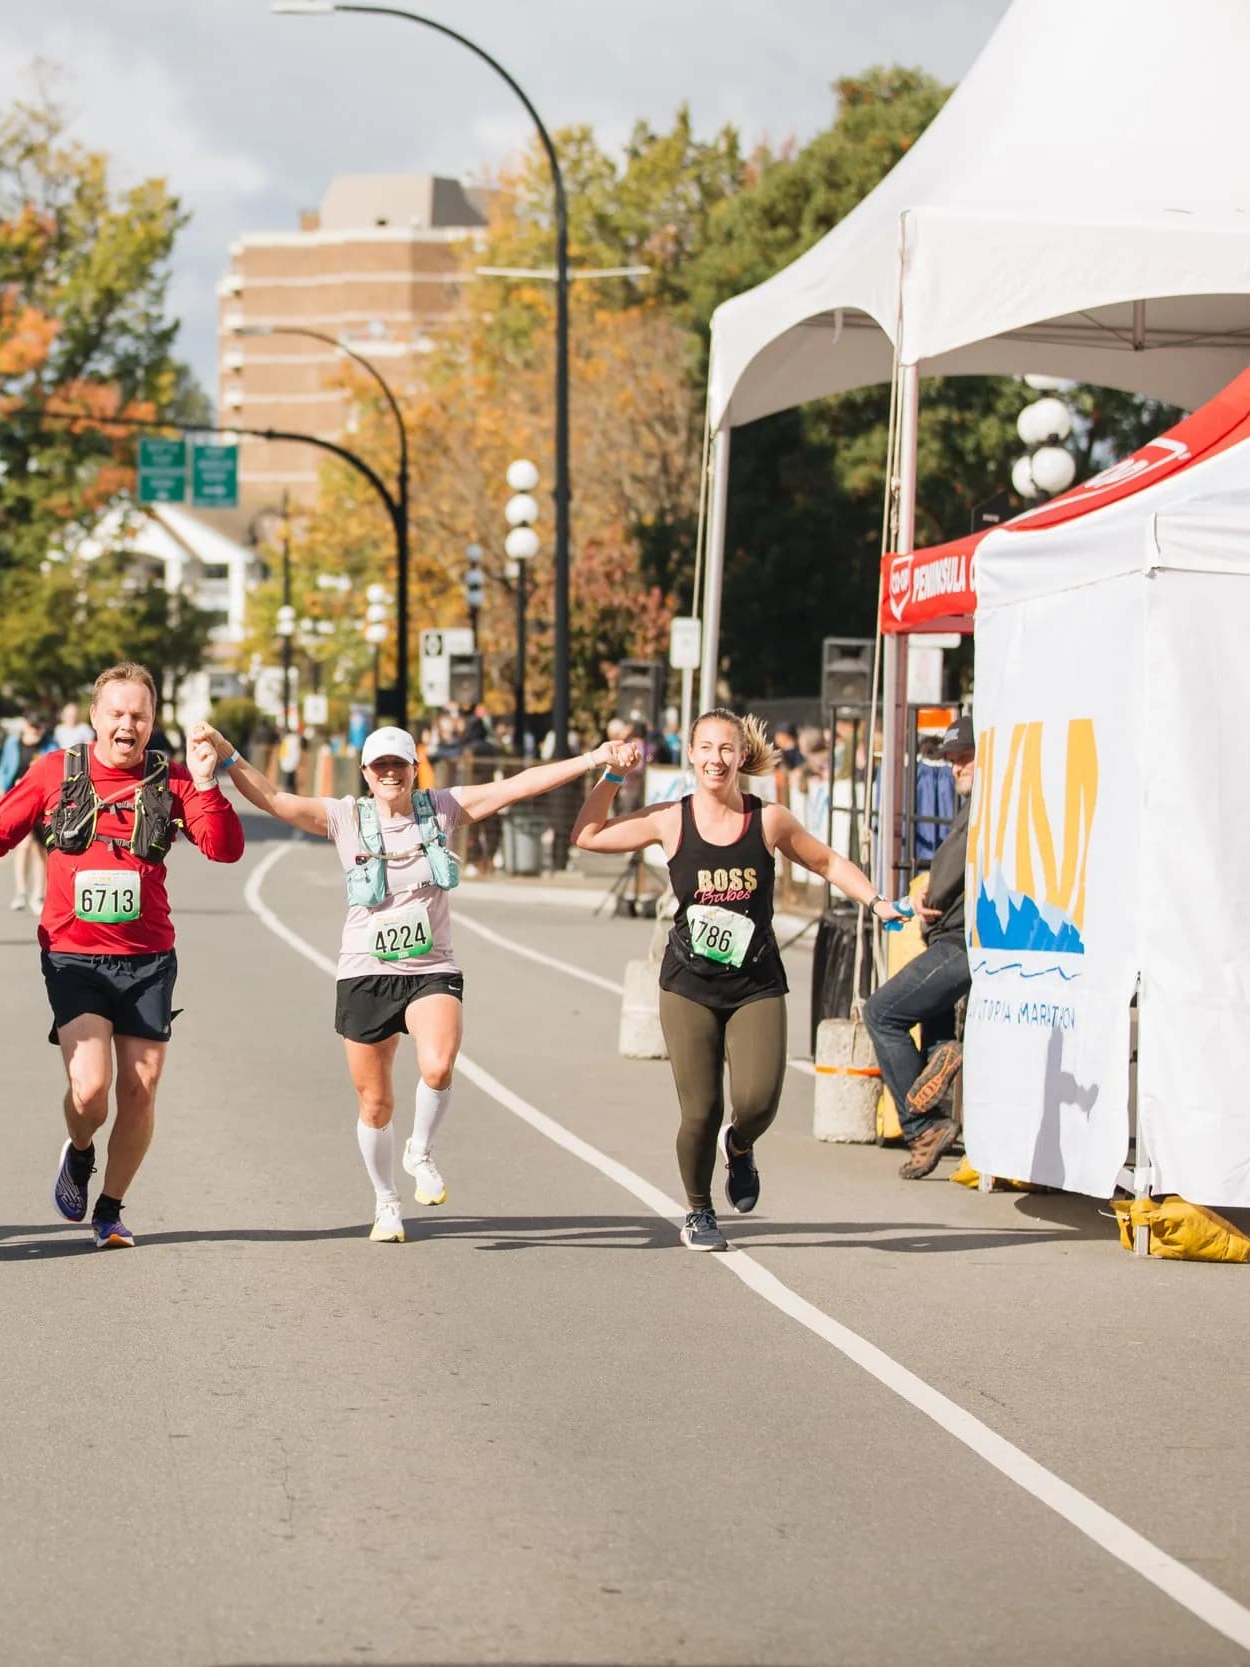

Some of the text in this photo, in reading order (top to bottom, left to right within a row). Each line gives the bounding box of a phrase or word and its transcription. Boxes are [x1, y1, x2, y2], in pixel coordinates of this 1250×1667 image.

[911, 555, 967, 604] PENINSULA
[697, 867, 758, 893] BOSS
[81, 889, 134, 913] 6713
[693, 884, 753, 905] Babes
[375, 921, 427, 953] 4224
